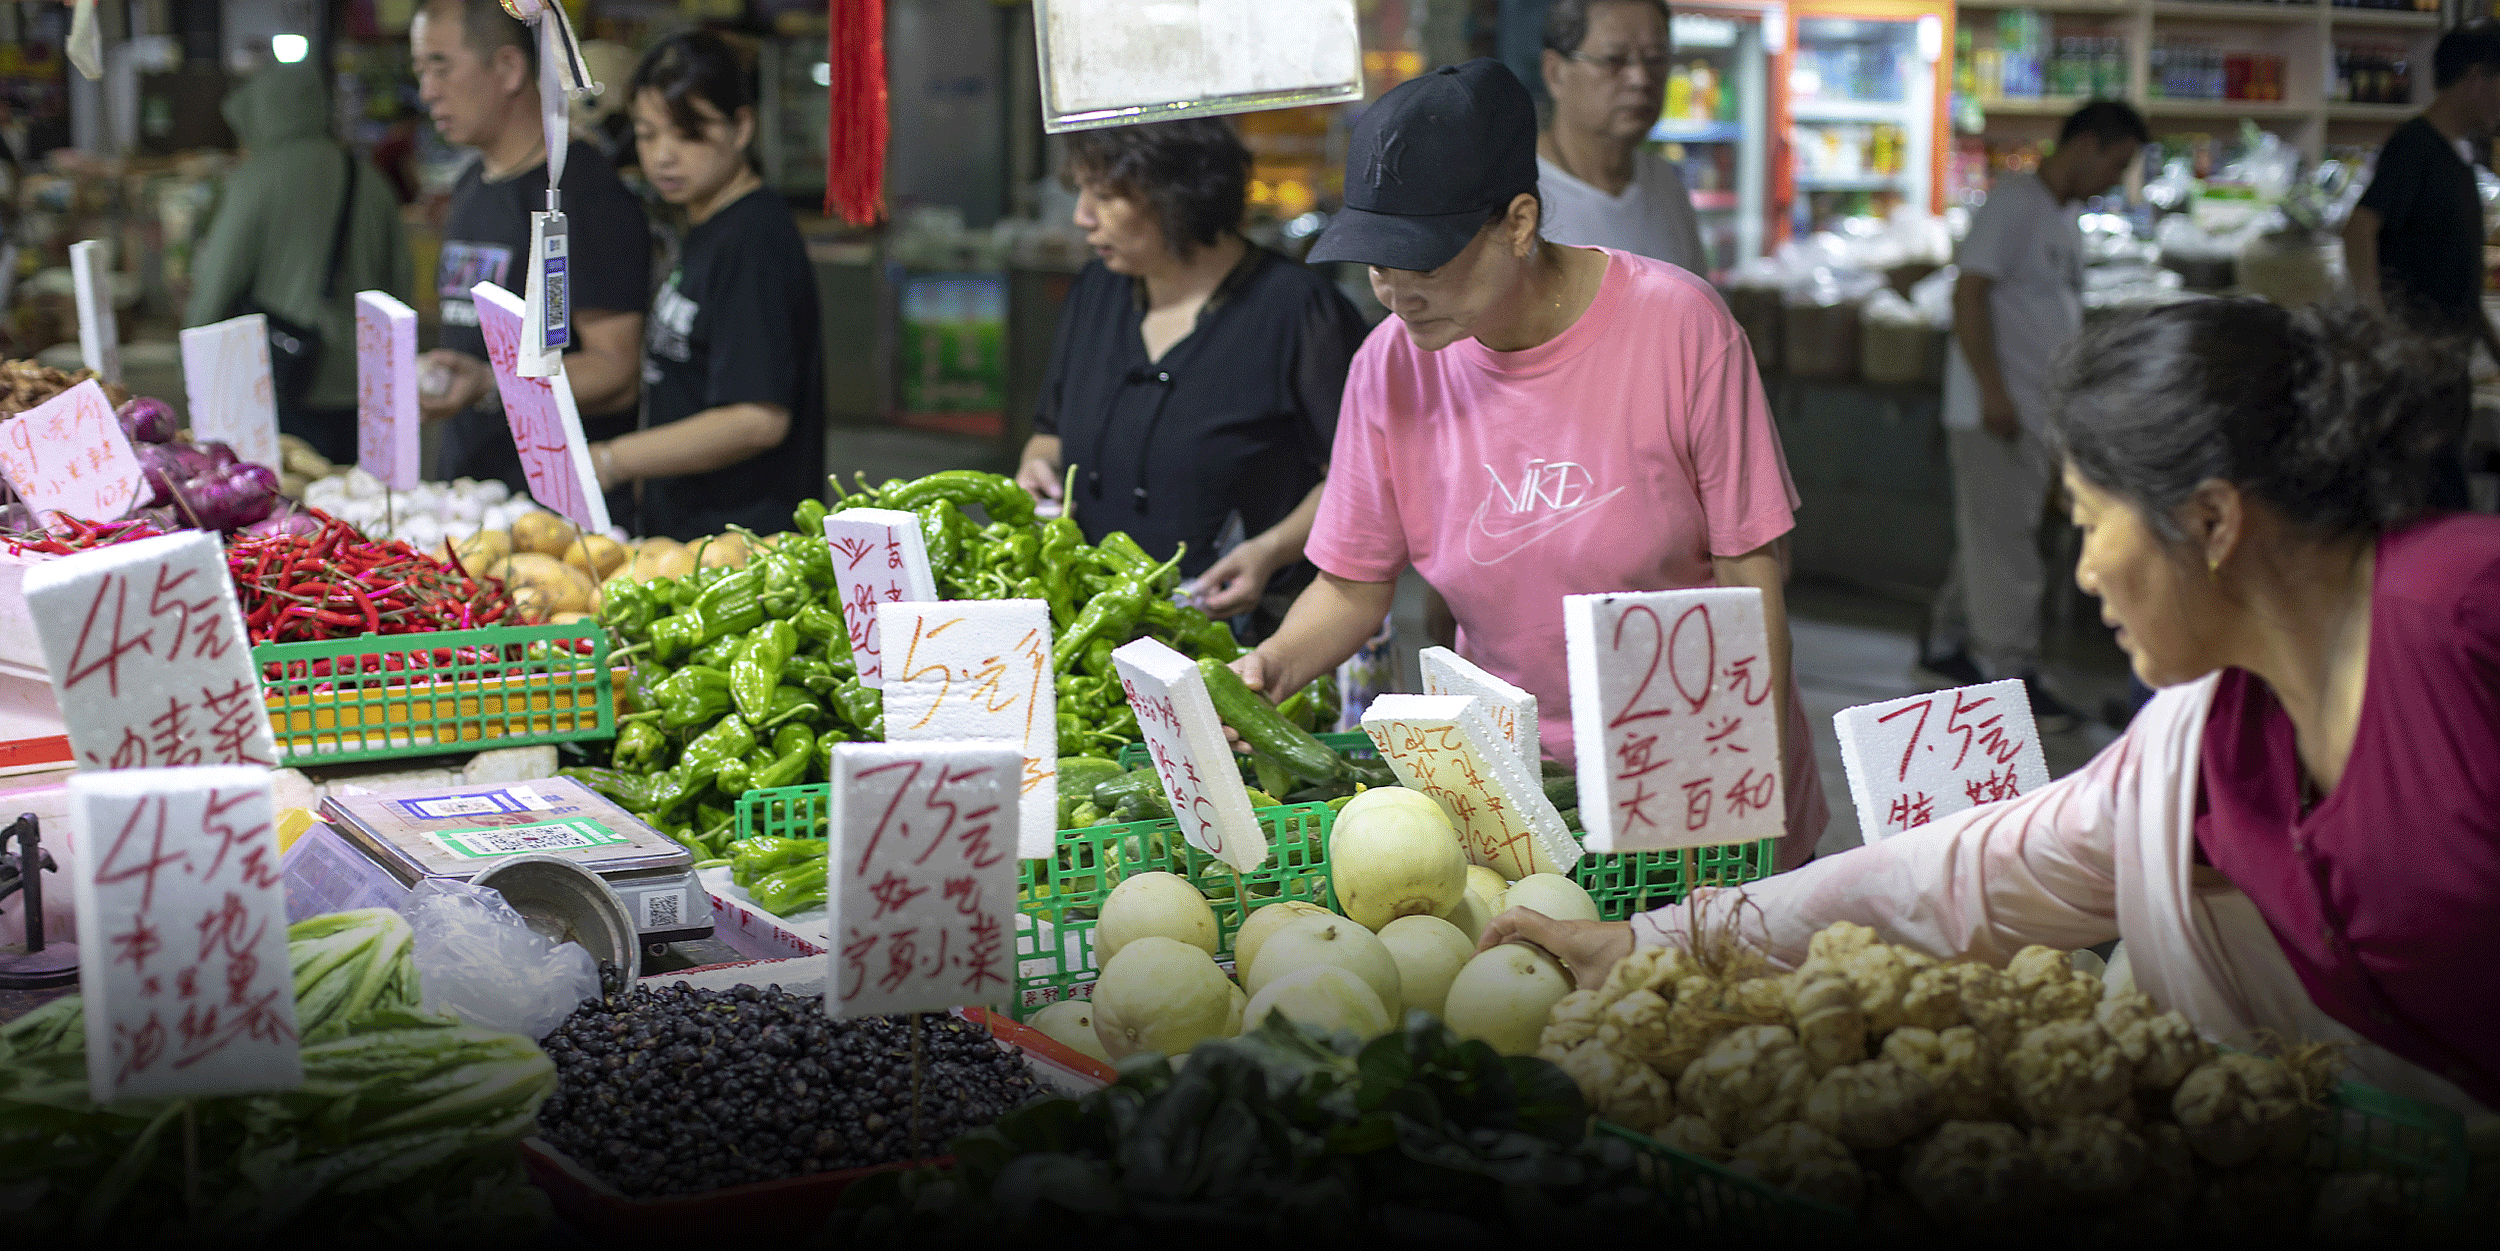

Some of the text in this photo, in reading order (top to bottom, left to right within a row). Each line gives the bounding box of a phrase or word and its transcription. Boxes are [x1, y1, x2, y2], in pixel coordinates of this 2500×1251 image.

[1480, 458, 1594, 515] NIKE
[1877, 691, 2024, 783] 7.5元
[94, 787, 283, 914] 4.5元
[853, 760, 1007, 877] 7.5元
[869, 870, 984, 920] 好吃
[840, 911, 1009, 1002] 宁夏小菜
